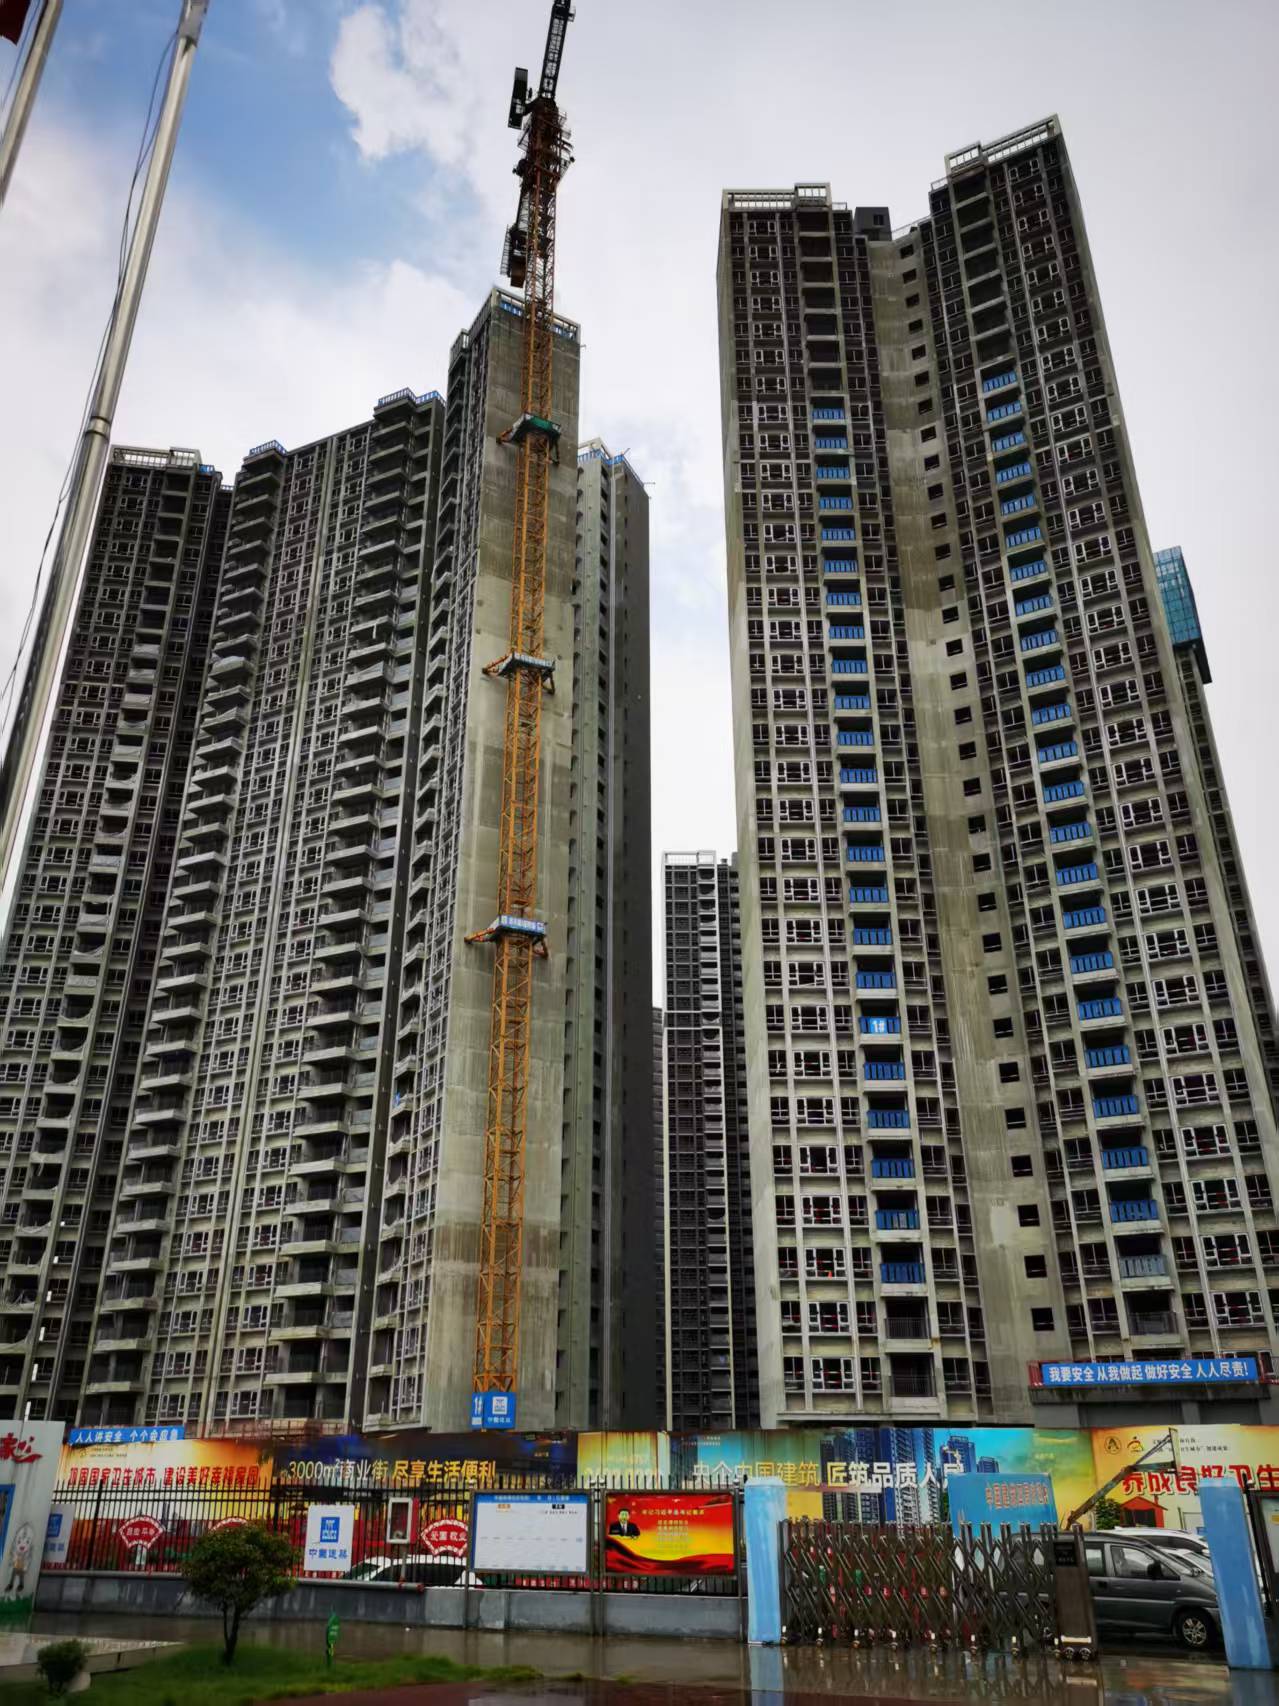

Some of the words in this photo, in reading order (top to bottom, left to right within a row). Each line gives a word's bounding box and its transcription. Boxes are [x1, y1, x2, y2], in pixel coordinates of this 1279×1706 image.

[1048, 1365, 1095, 1383] 我要安全
[1097, 1364, 1143, 1381] 从我做起
[1144, 1362, 1193, 1380] 做好安全
[1196, 1360, 1249, 1378] 人人尽责!
[163, 1465, 260, 1488] 建设美好幸福家园
[392, 1459, 497, 1483] 尽享生活便利
